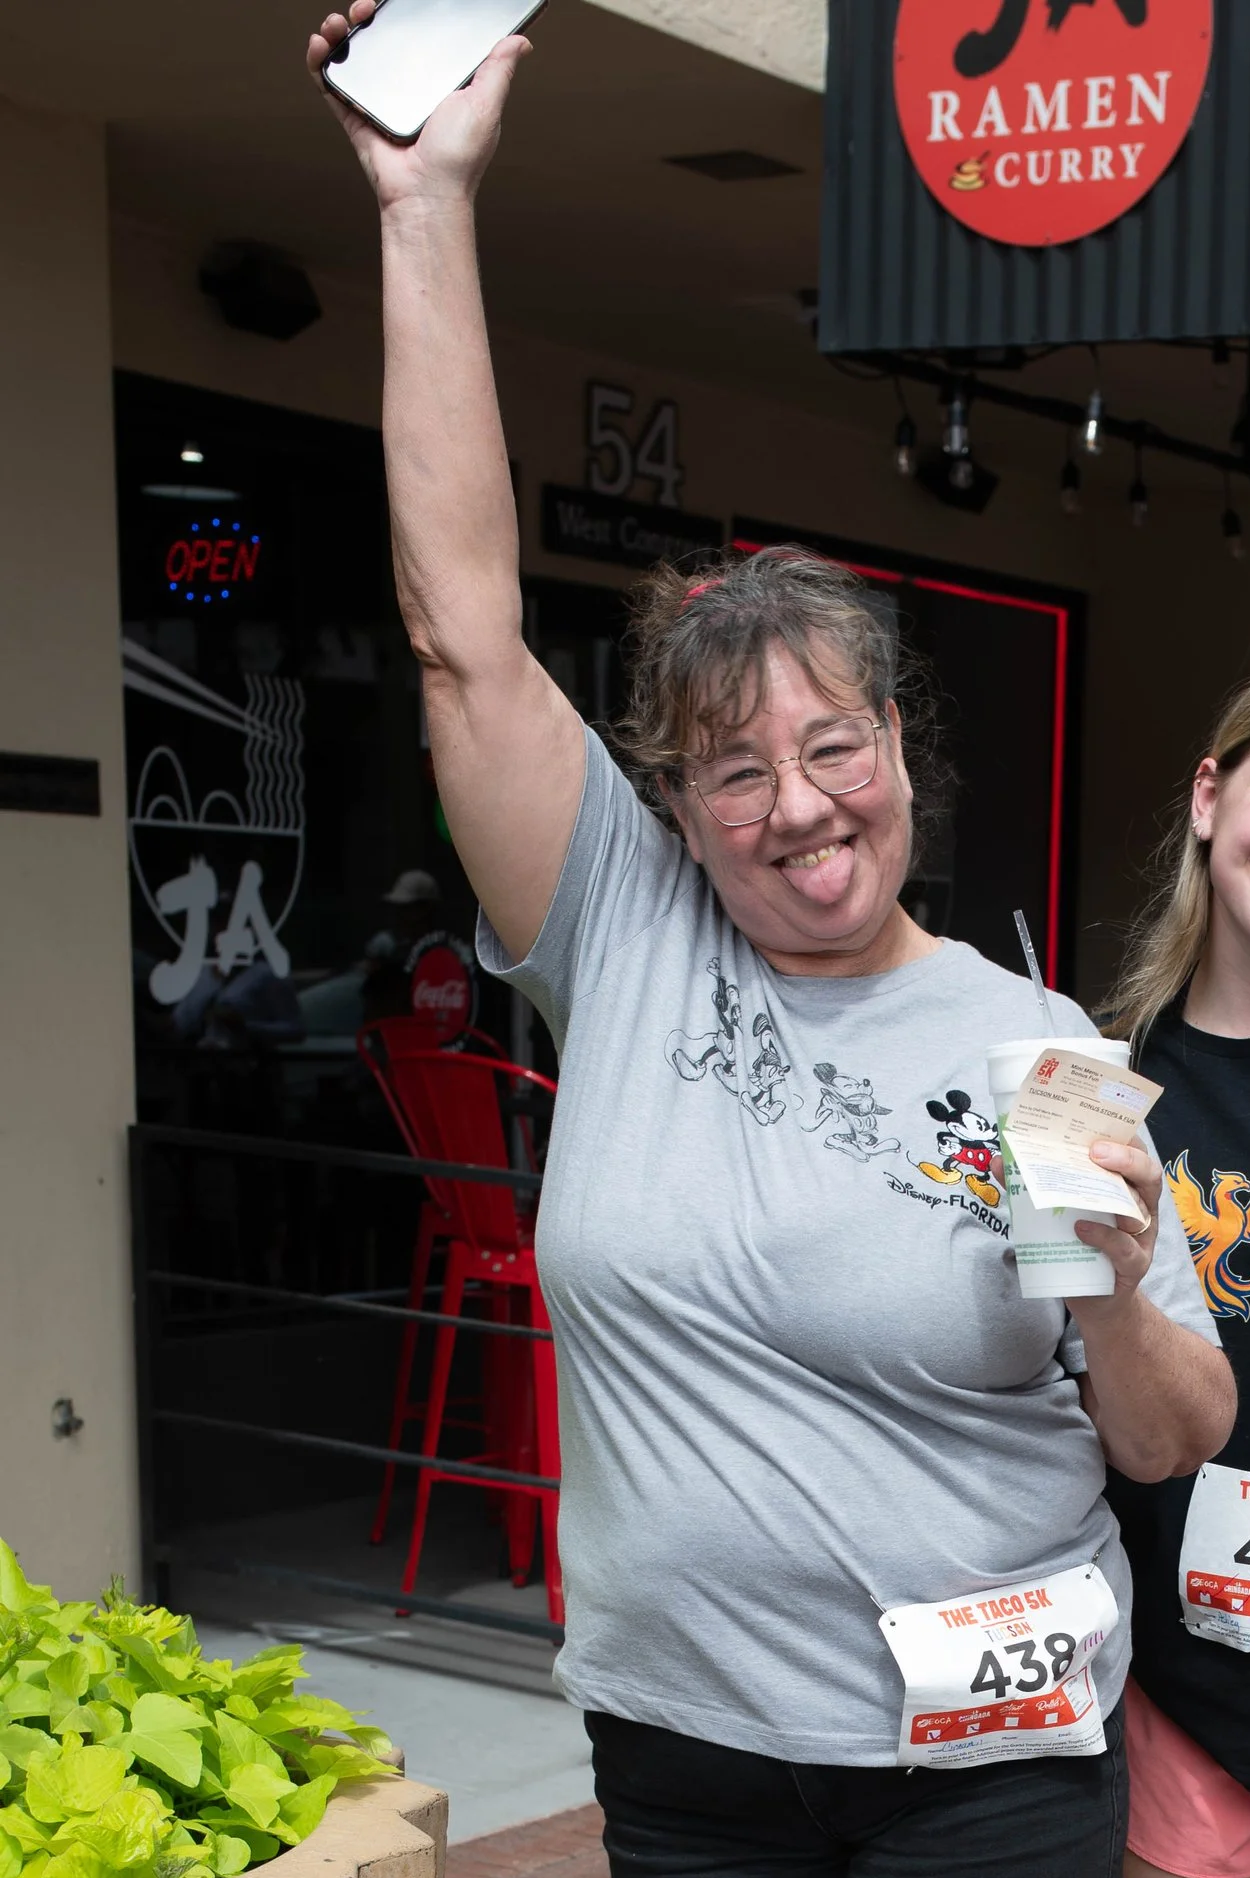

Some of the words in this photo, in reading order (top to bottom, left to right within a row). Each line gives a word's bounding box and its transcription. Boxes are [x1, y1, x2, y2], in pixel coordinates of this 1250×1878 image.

[926, 71, 1172, 142] RAMEN
[994, 142, 1145, 188] CURRY
[587, 382, 683, 509] 54
[164, 539, 261, 583] OPEN
[1028, 1087, 1052, 1099] TUCSON
[1052, 1093, 1069, 1103] MENU
[1080, 1101, 1100, 1113] BONUS
[1100, 1108, 1120, 1119] STOPS
[1124, 1116, 1136, 1125] FUN
[938, 1605, 978, 1628] THE
[976, 1594, 1025, 1621] TACO
[1024, 1587, 1053, 1609] 5K
[985, 1621, 1033, 1642] TUCSON
[969, 1632, 1077, 1699] 438
